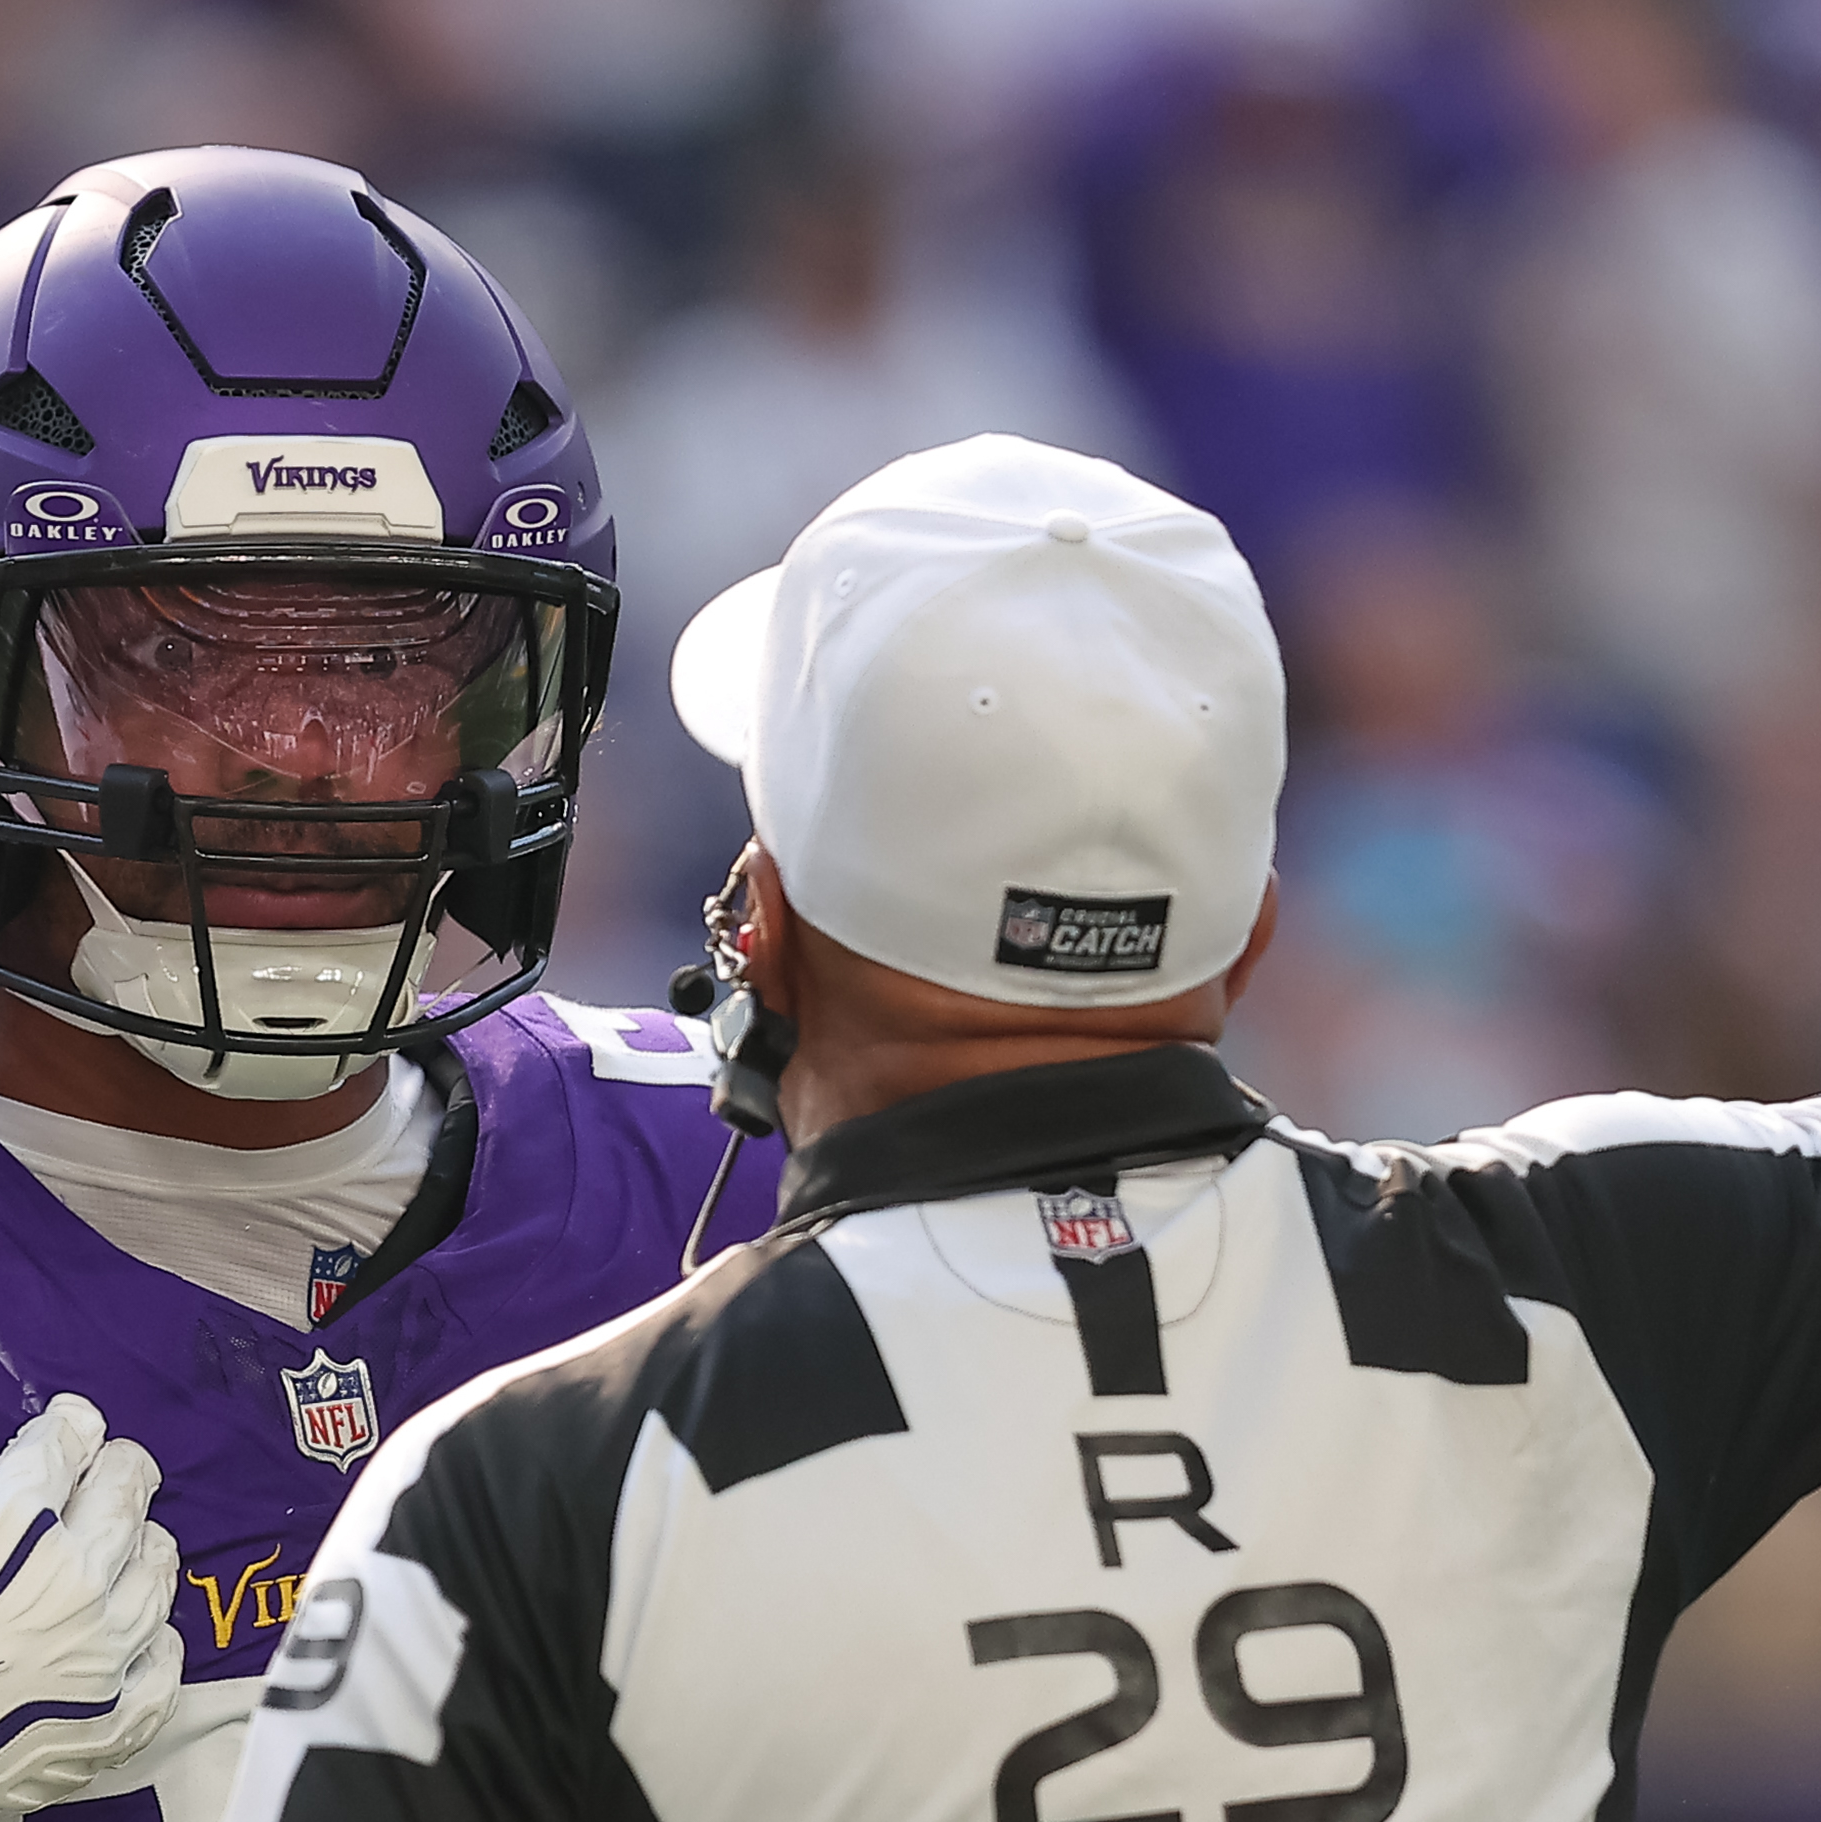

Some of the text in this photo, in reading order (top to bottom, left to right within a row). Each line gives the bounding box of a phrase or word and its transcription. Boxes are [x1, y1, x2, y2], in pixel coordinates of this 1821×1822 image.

[9, 520, 117, 543] OAKLEY
[490, 527, 567, 550] OAKLEY
[1050, 923, 1163, 955] CATCH
[1049, 1217, 1129, 1252] NFL
[304, 1403, 372, 1454] NFL
[1074, 1429, 1240, 1569] R
